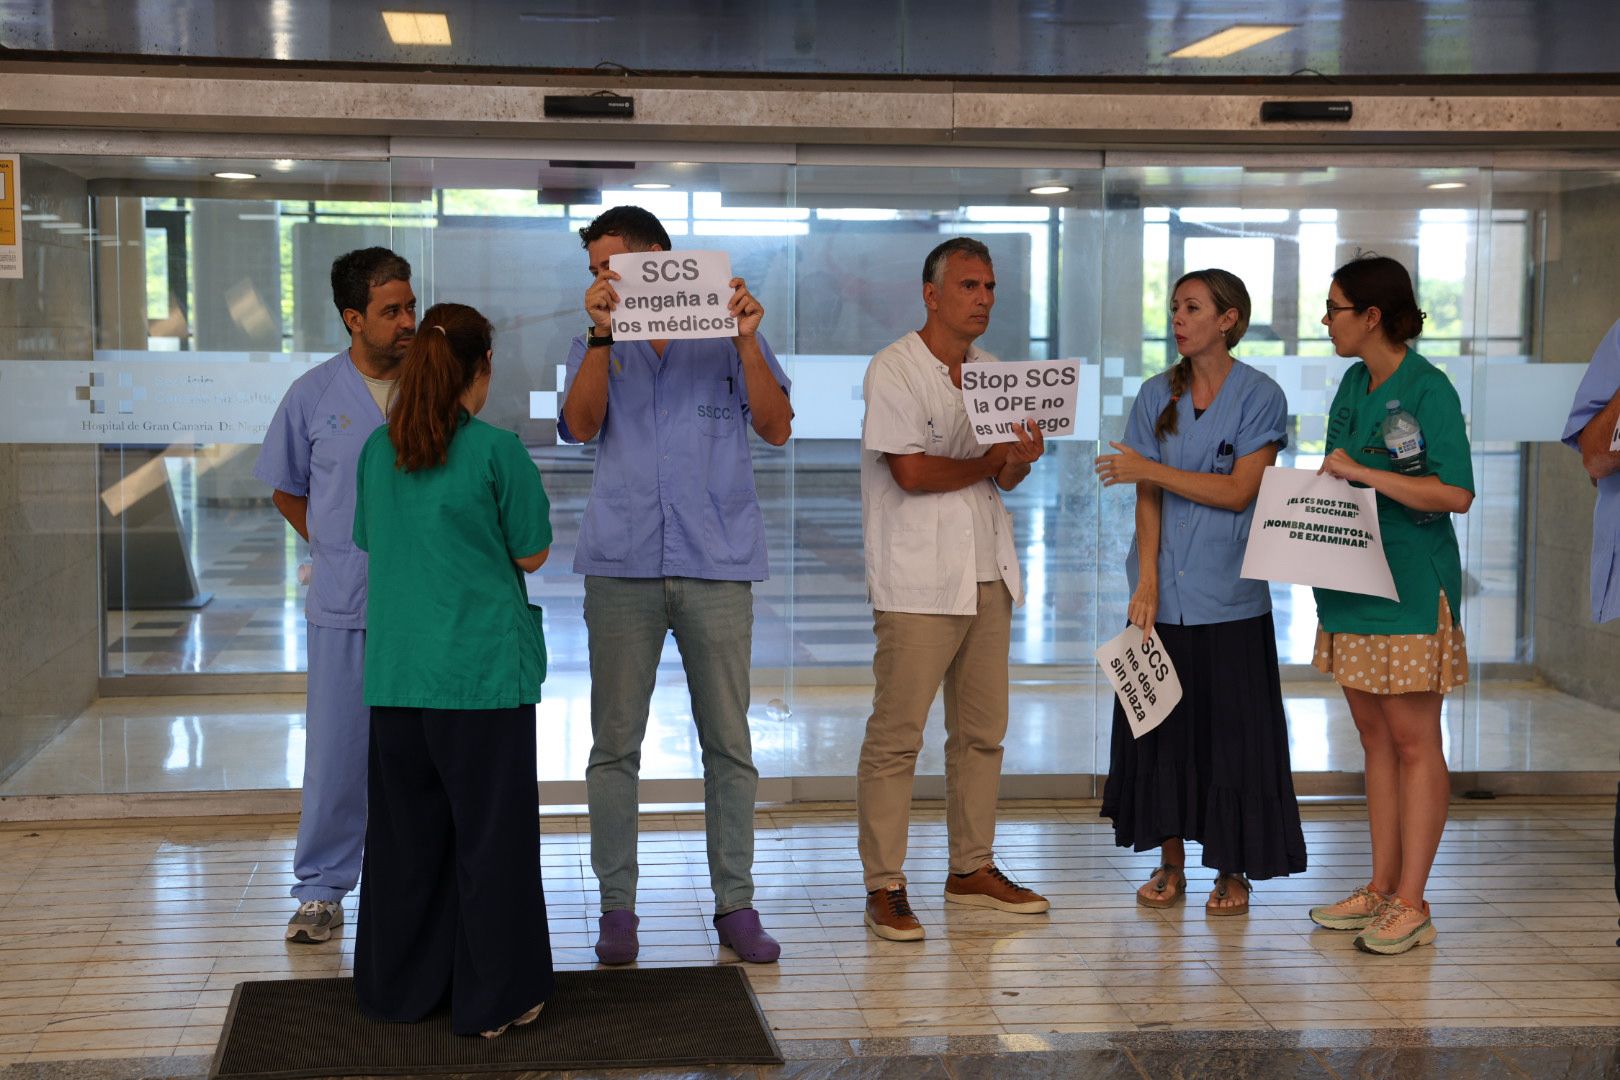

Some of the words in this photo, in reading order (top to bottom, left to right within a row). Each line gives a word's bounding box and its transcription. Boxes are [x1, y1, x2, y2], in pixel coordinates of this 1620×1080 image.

[642, 259, 699, 283] SCS
[624, 291, 701, 312] engaña
[707, 292, 719, 306] a
[612, 318, 642, 333] los
[648, 315, 735, 332] médicos
[963, 371, 1018, 392] Stop
[1025, 367, 1075, 388] SCS
[974, 398, 989, 414] la
[994, 396, 1036, 411] OPE
[1041, 397, 1064, 409] no
[82, 420, 125, 433] Hospital
[127, 420, 140, 431] de
[142, 421, 169, 431] Gran
[172, 421, 213, 431] Canaria
[975, 423, 993, 435] es
[1316, 499, 1336, 507] NOS
[1263, 519, 1365, 537] ¡NOMBRAMIENTOS
[1289, 531, 1304, 540] DE
[1305, 533, 1368, 549] EXAMINAR!
[1141, 636, 1169, 682] SCS
[1125, 647, 1140, 672] me
[1138, 671, 1157, 706] deja
[1110, 658, 1127, 681] sin
[1120, 682, 1146, 722] plaza
